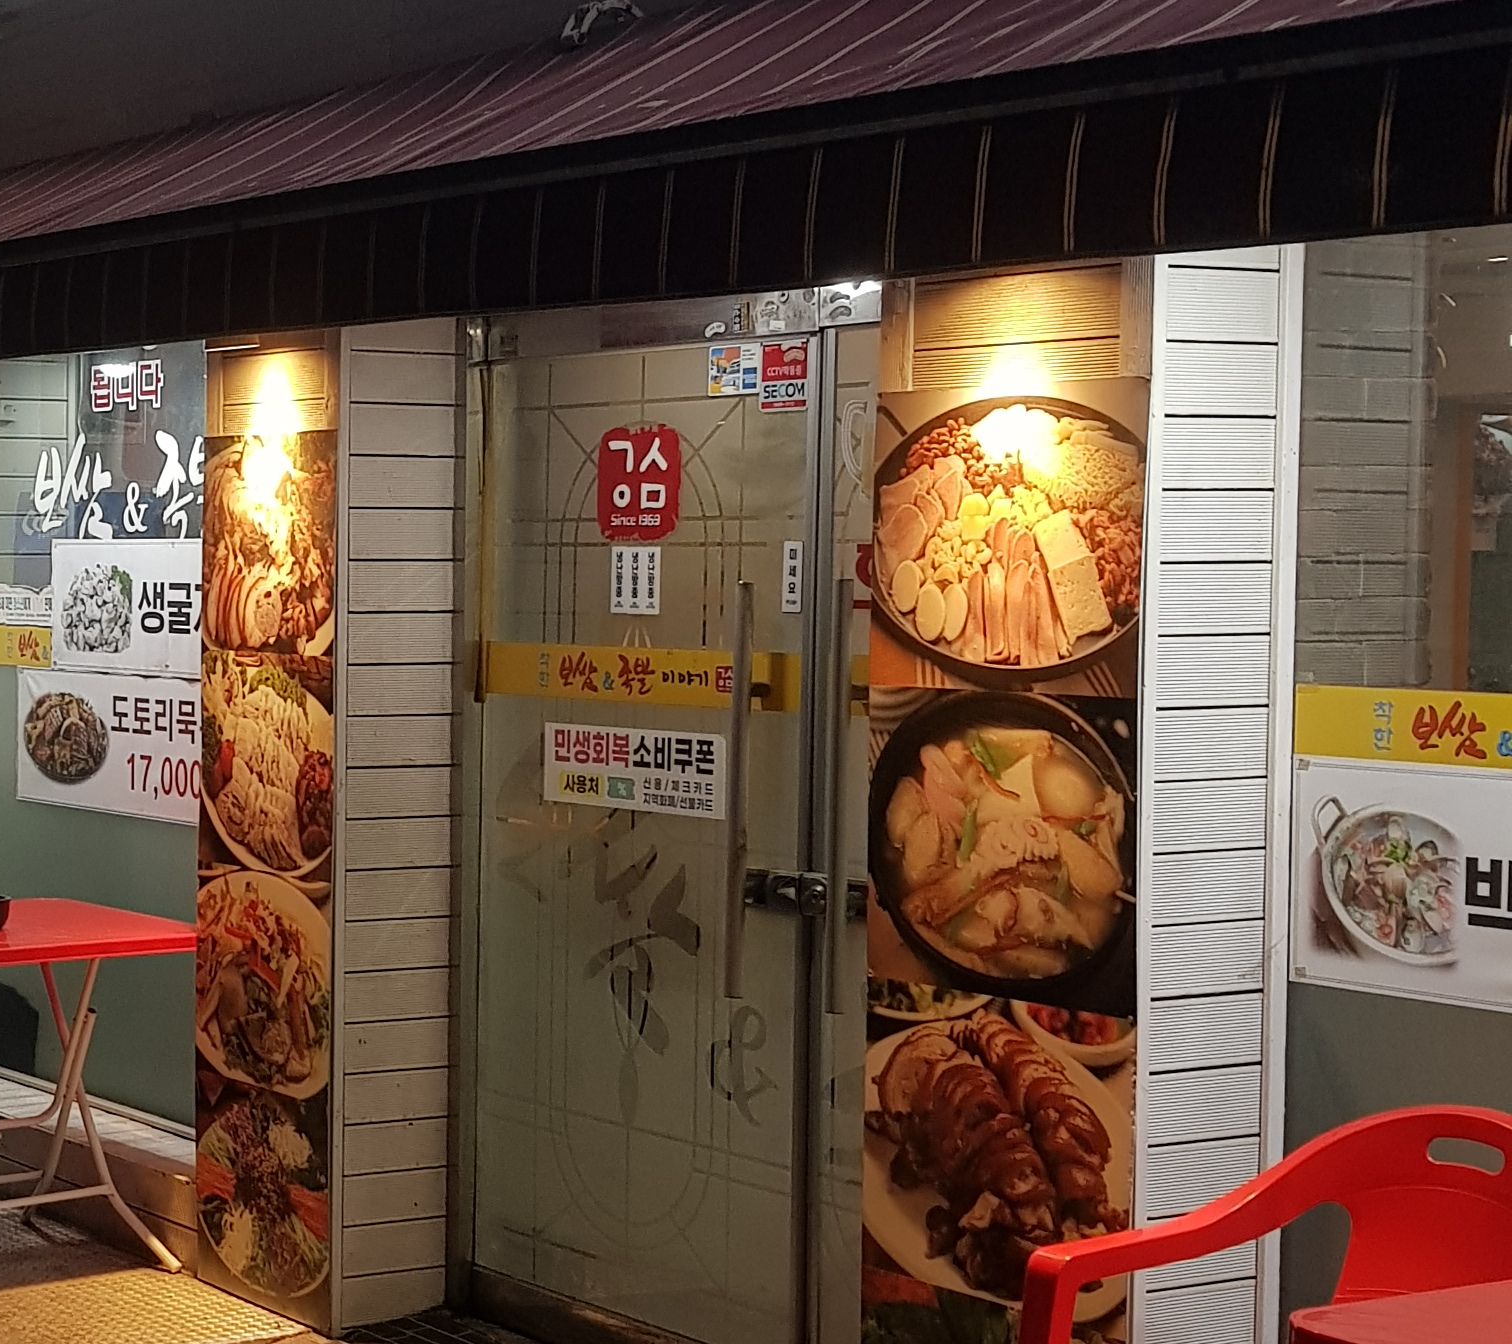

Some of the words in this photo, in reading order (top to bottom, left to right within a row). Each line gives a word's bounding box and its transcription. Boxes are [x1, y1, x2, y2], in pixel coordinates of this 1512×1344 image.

[763, 382, 805, 400] SECOM
[34, 432, 113, 538] 보쌈
[122, 481, 148, 533] &
[609, 513, 637, 526] Since
[137, 580, 201, 636] 생굴
[559, 651, 599, 693] 보쌈
[602, 670, 615, 691] &
[617, 653, 656, 696] 족발
[661, 669, 709, 687] 이야기
[110, 692, 200, 745] 도토리묵
[1372, 699, 1395, 754] 착한
[1410, 700, 1488, 760] 보쌈
[563, 774, 600, 796] 사용처
